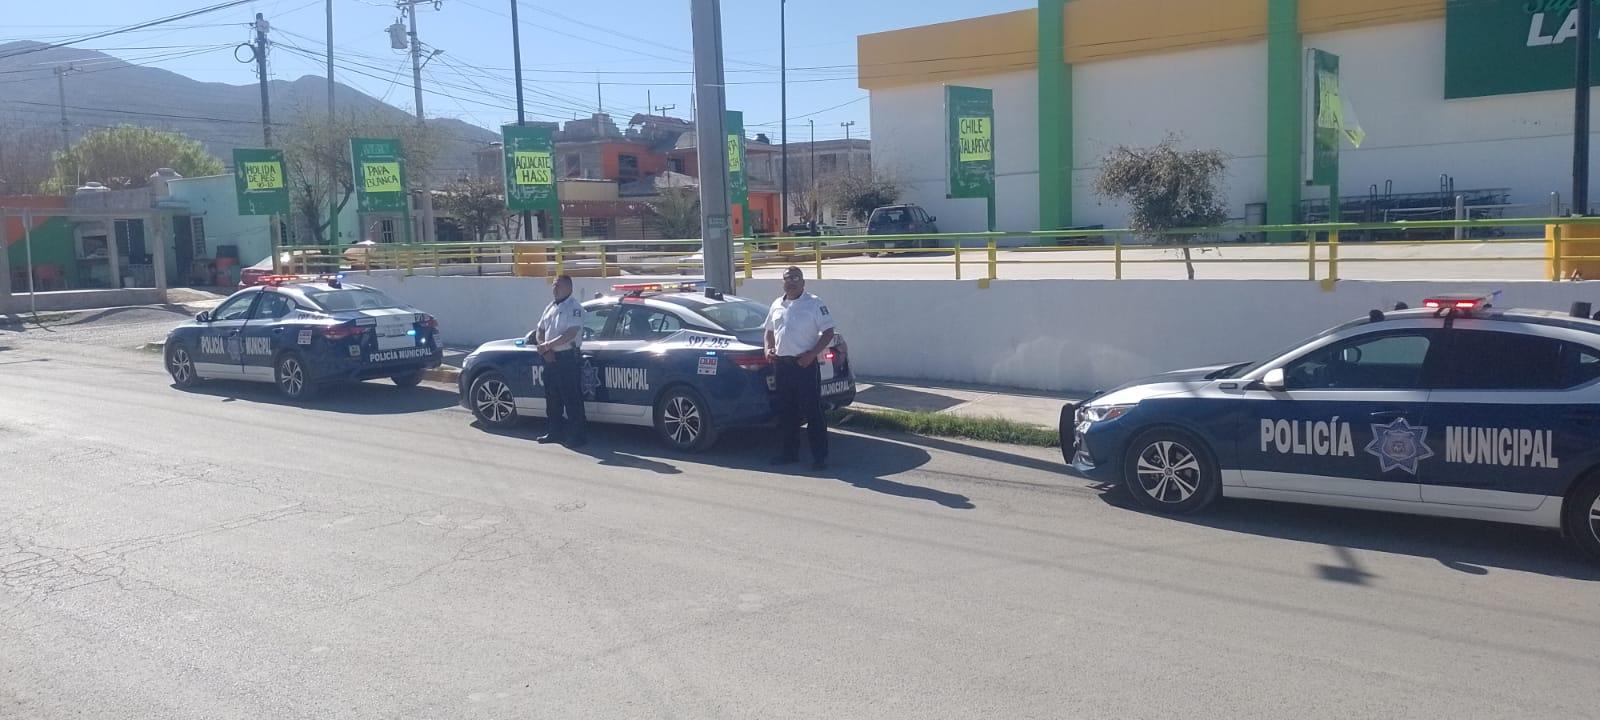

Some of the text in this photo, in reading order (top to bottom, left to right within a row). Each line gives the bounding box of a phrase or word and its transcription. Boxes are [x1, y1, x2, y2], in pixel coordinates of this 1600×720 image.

[960, 119, 983, 134] CHILE
[516, 156, 551, 169] AGUACATE
[367, 165, 390, 177] PAPA
[522, 169, 549, 183] HASS
[249, 174, 258, 183] DE
[366, 174, 399, 188] BLANCA
[245, 336, 272, 356] MUNICIPAL
[399, 347, 432, 359] MUNICIPAL
[605, 366, 649, 390] MUNICIPAL
[821, 380, 850, 396] MUNICIPAL
[1261, 415, 1559, 469] POLICÍA MUNICIPAL
